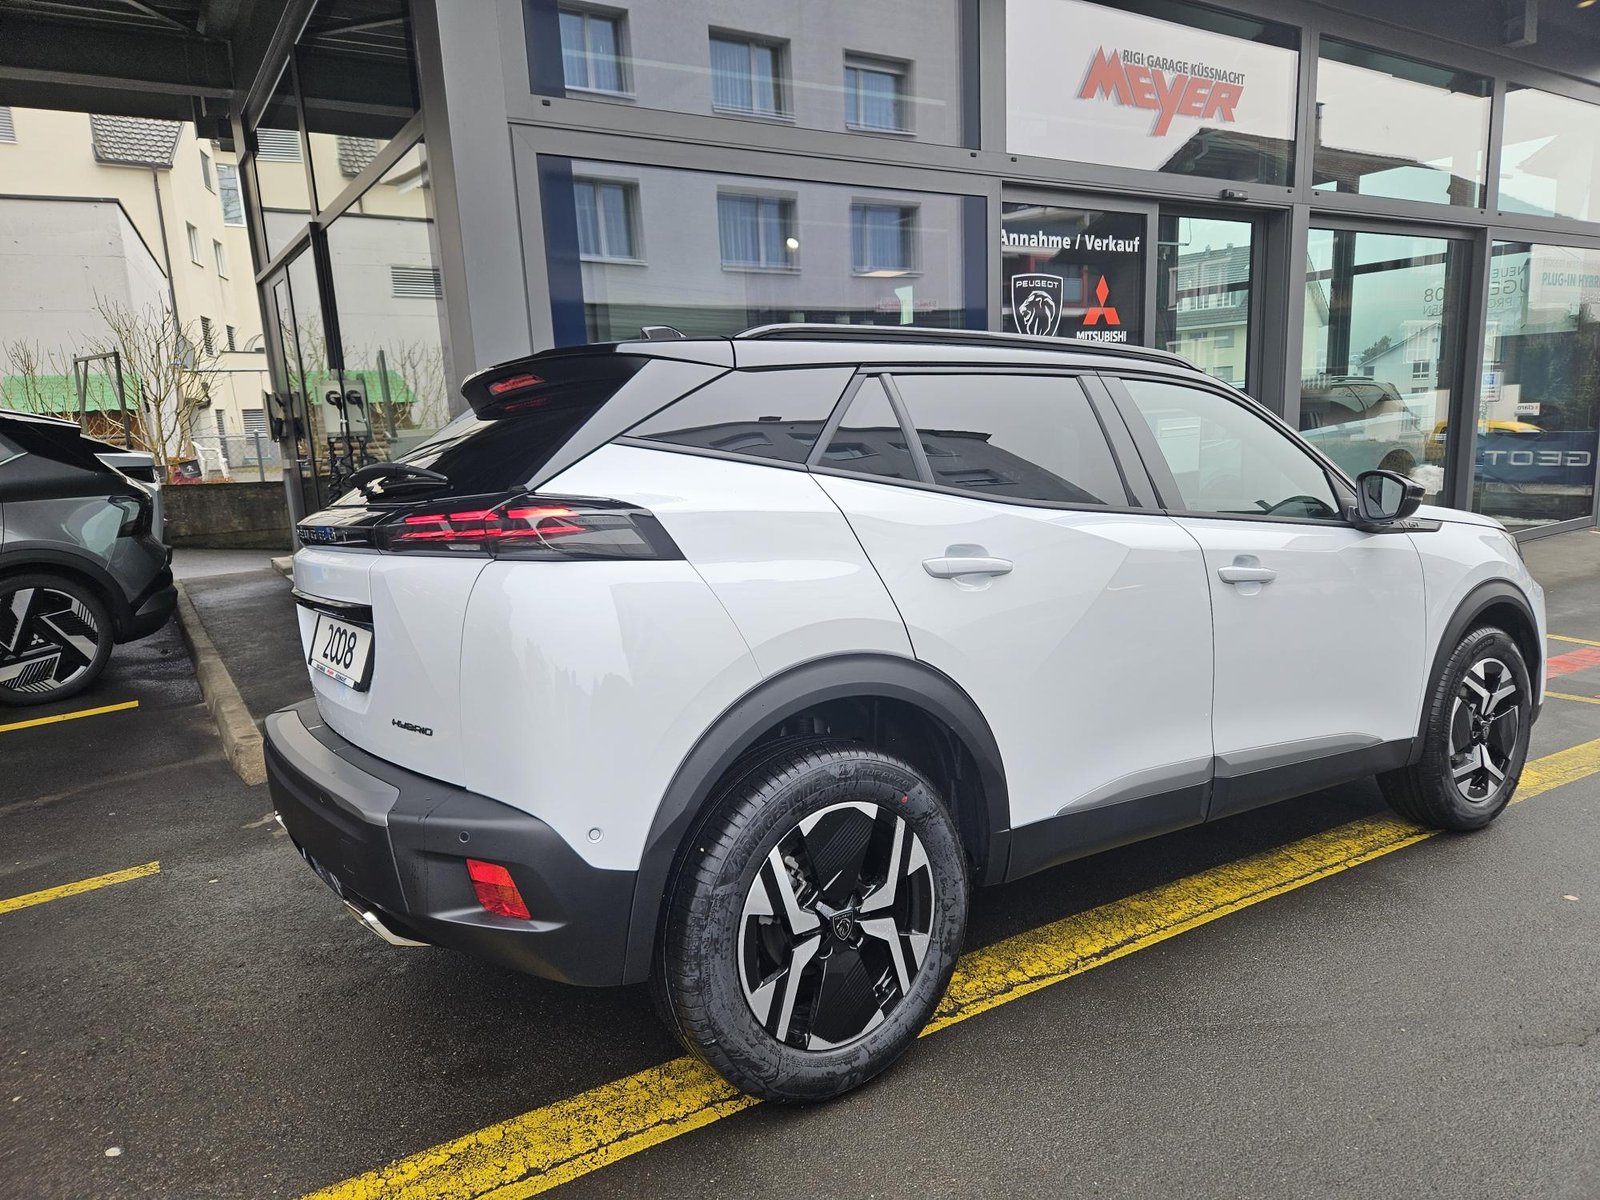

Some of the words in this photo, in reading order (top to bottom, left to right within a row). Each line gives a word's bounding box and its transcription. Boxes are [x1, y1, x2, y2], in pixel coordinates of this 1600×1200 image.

[1123, 49, 1144, 65] RIGI
[1147, 55, 1188, 74] GARAGE
[1190, 62, 1245, 85] KÜSSNACHT
[1077, 44, 1244, 137] MEYER
[1001, 228, 1071, 249] Annahme
[1085, 234, 1140, 252] Verkauf
[1016, 279, 1059, 289] PEUGEOT
[1541, 271, 1577, 287] PLUG-IN
[1076, 330, 1127, 343] MITSUBISHI
[322, 623, 358, 670] 2008
[391, 718, 434, 737] HYBRID
